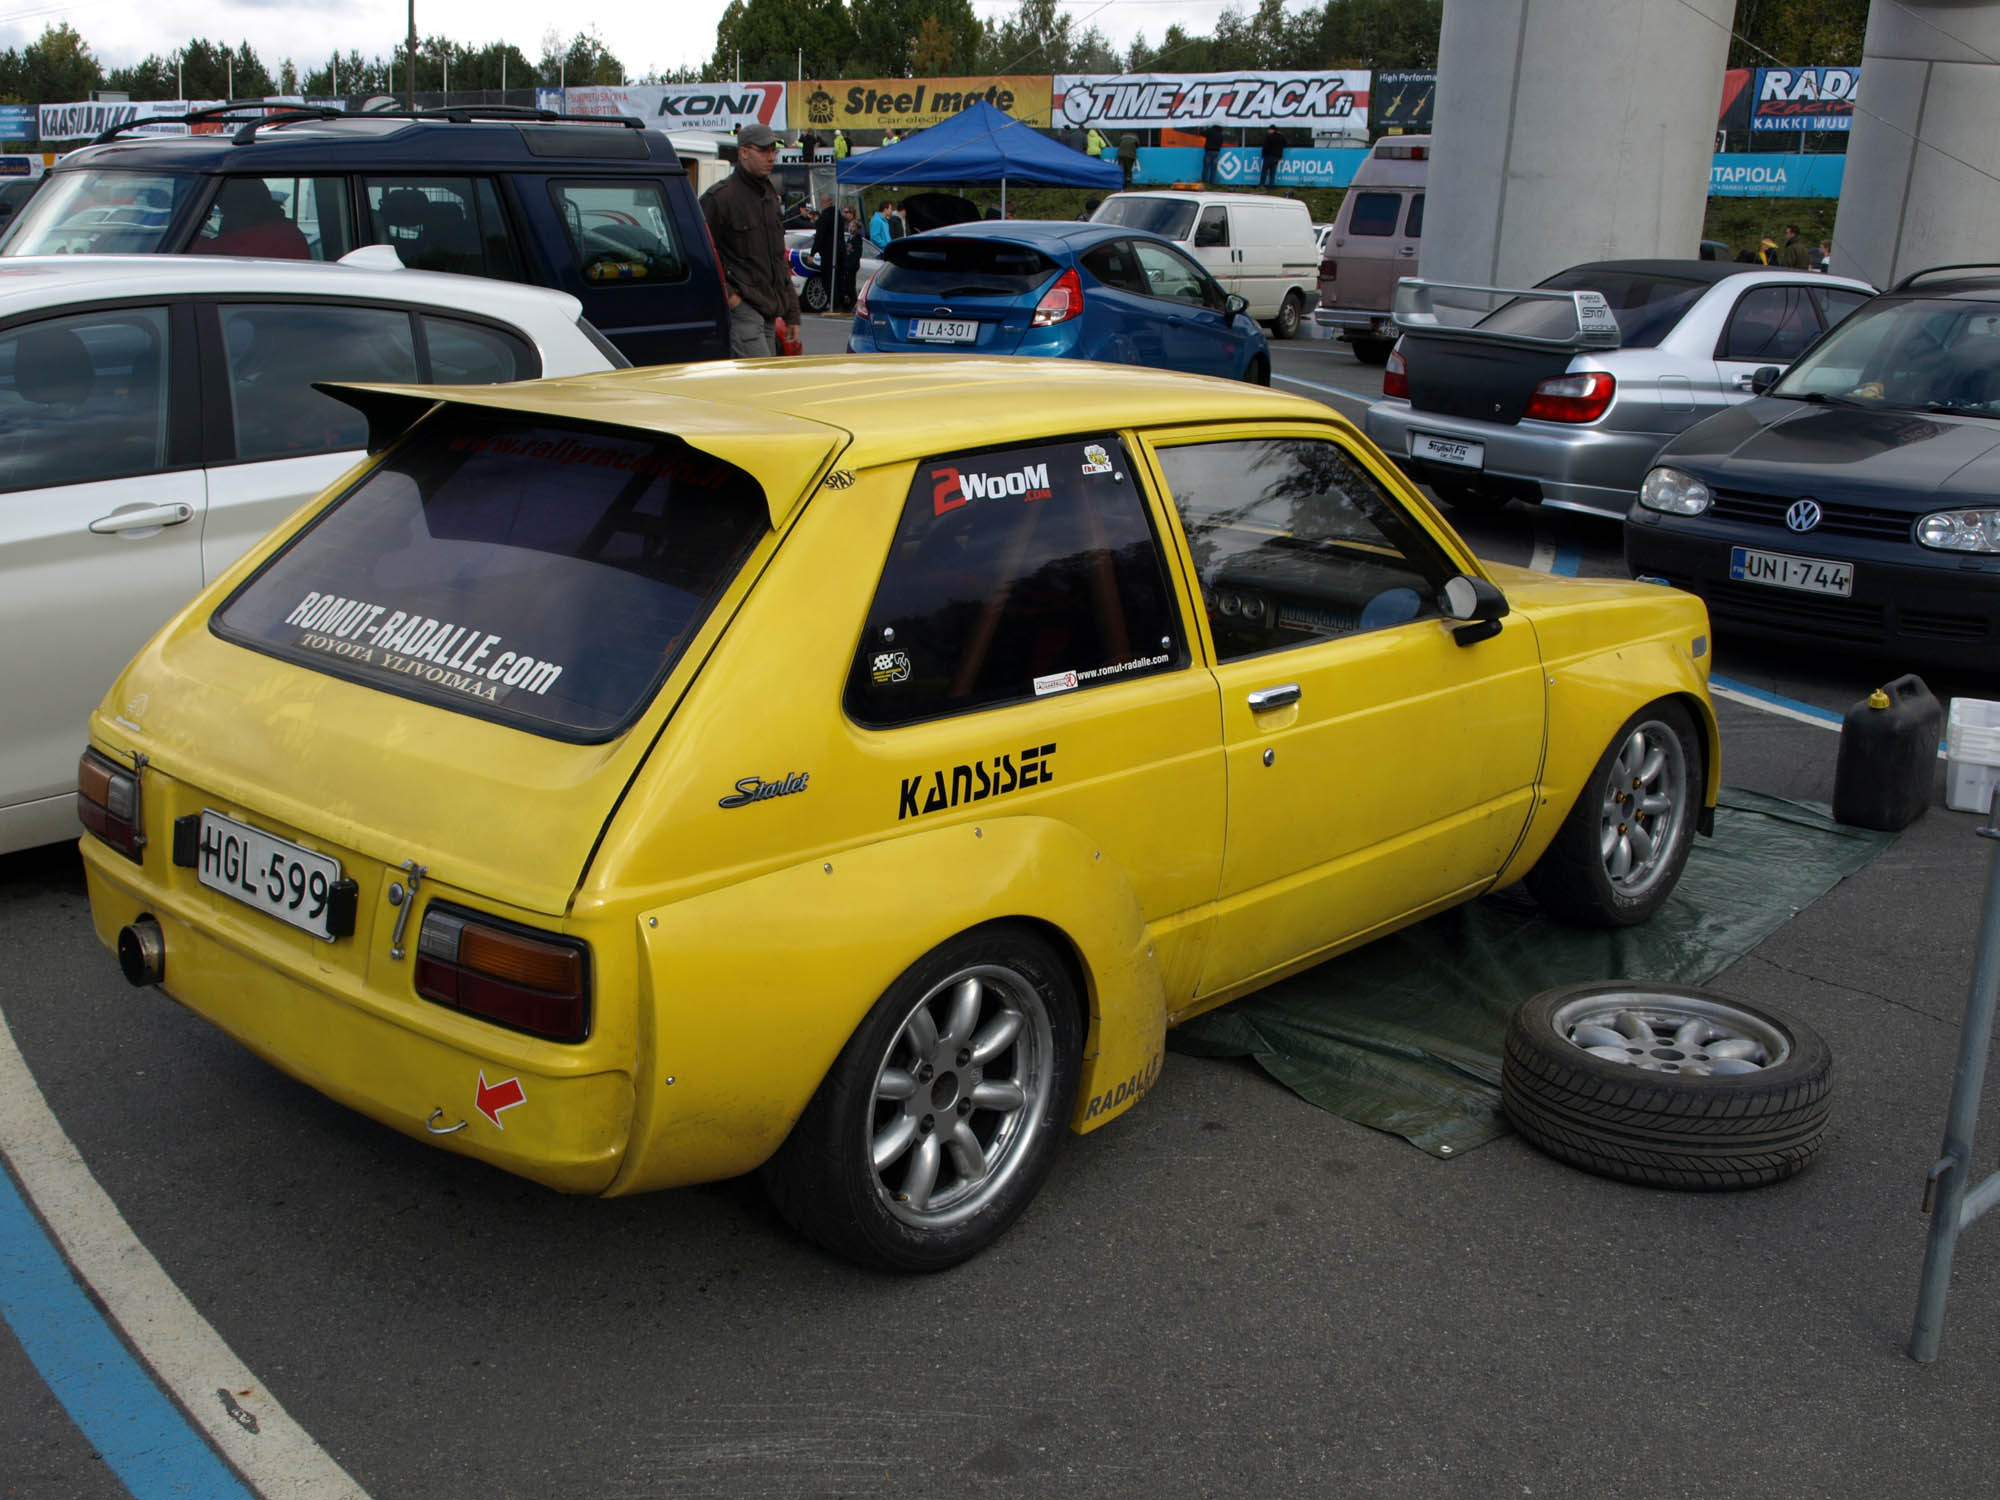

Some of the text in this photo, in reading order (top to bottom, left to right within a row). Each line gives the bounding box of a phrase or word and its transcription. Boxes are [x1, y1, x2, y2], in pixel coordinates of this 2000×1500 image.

[1380, 73, 1398, 84] High
[658, 94, 759, 117] KONI
[844, 85, 1014, 115] Steel mate
[1088, 82, 1180, 119] TIME
[681, 117, 727, 128] www.koni.fi
[877, 116, 901, 125] Car
[1754, 118, 1849, 129] KAIKKI MUU
[284, 591, 563, 695] ROMUT-RADALLE.com
[301, 633, 498, 701] TOYOTA YLIVOIMAA
[1077, 654, 1169, 681] www.romut-radalle.com
[719, 772, 810, 809] Starlet
